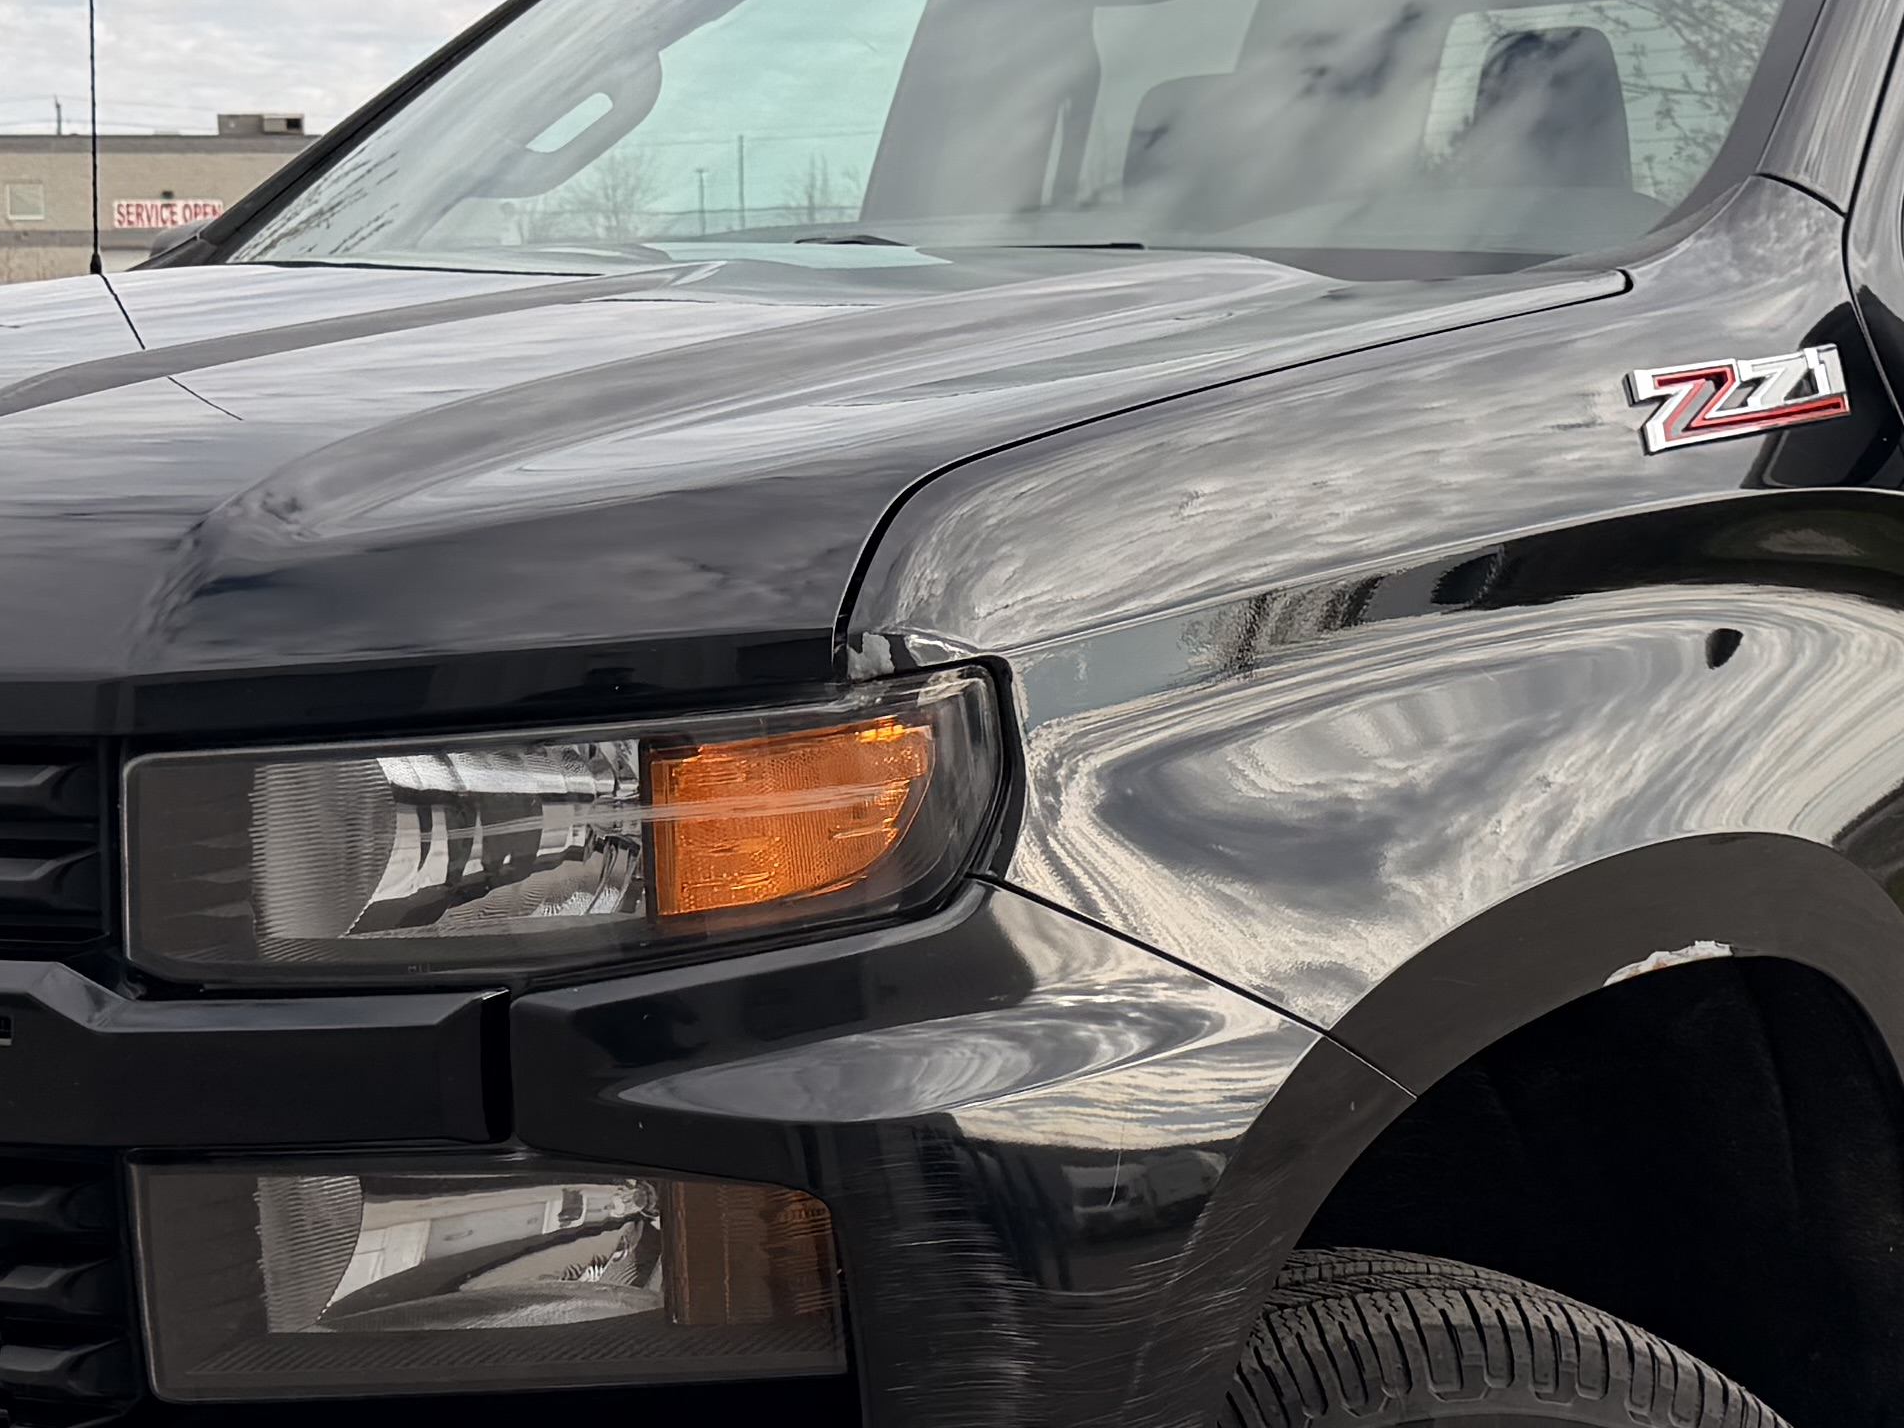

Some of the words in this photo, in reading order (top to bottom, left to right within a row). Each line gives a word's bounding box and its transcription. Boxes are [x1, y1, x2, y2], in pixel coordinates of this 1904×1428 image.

[116, 202, 178, 227] SERVICE
[182, 203, 222, 224] OPEN
[1622, 343, 1850, 456] Z71
